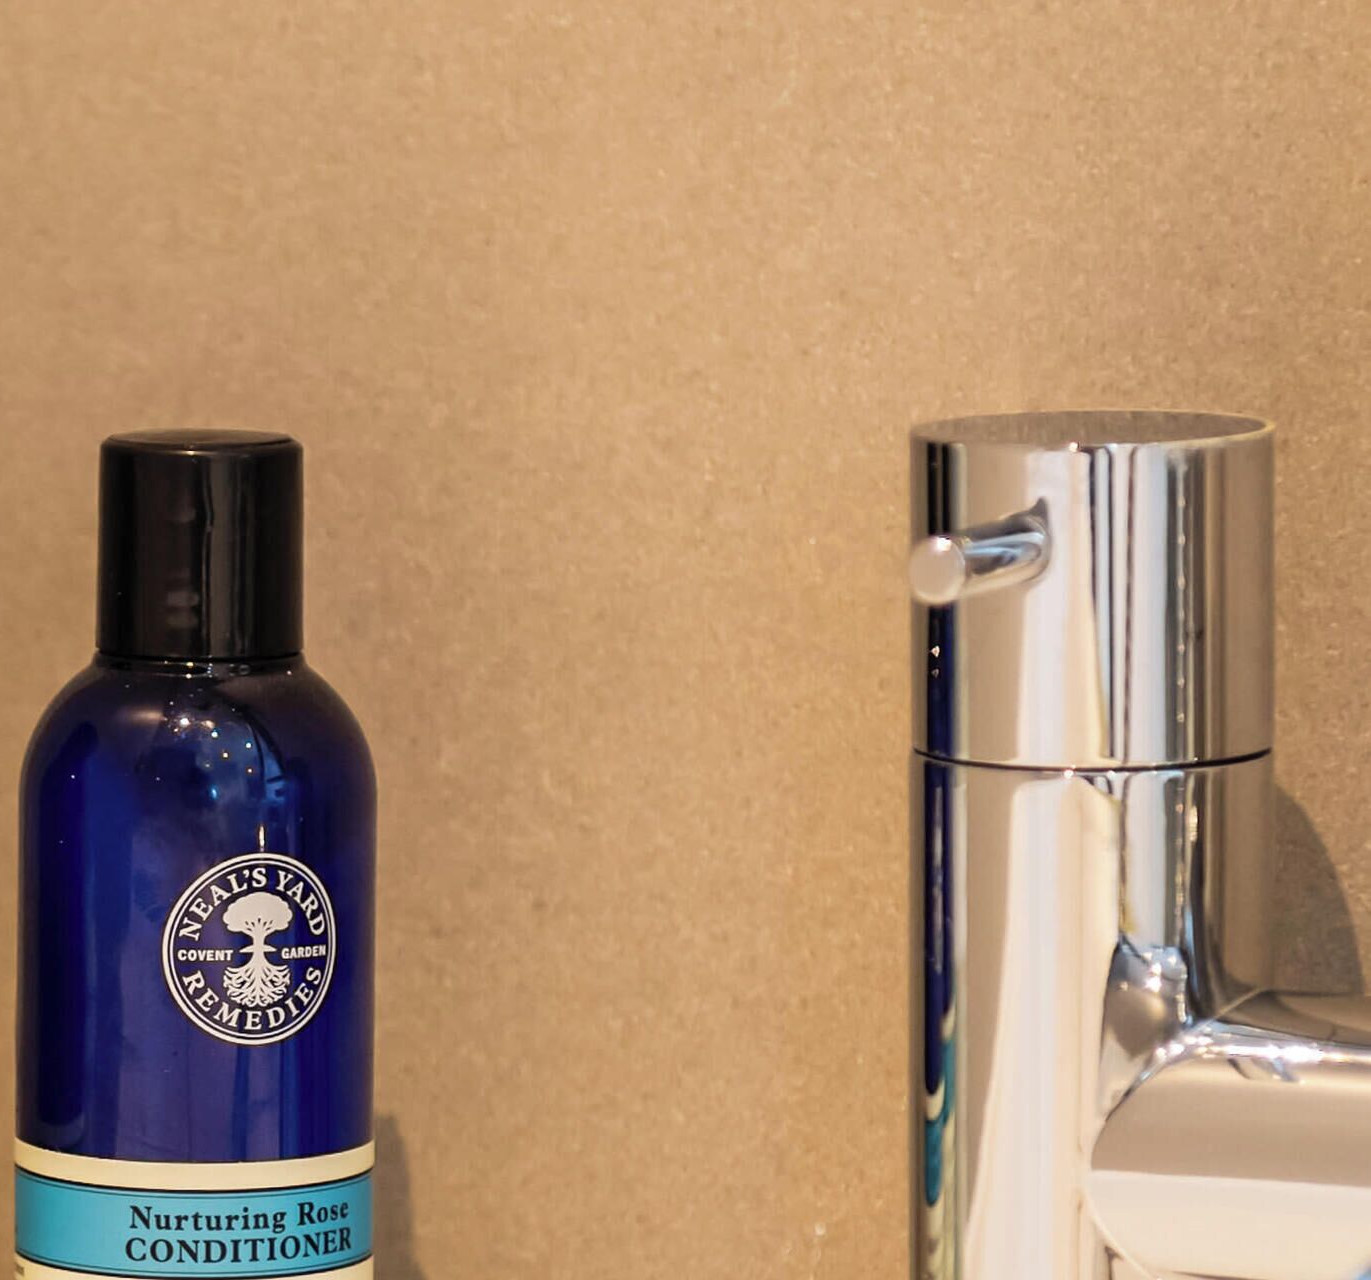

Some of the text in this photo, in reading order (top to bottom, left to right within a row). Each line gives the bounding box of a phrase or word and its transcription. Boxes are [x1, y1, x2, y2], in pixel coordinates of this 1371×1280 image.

[179, 868, 325, 941] NEAL'S YARD
[178, 945, 326, 961] COVENT GARDEN
[182, 967, 321, 1030] REMEDIES
[130, 1201, 349, 1234] Nurturing Rose
[125, 1227, 352, 1264] CONDITIONER
